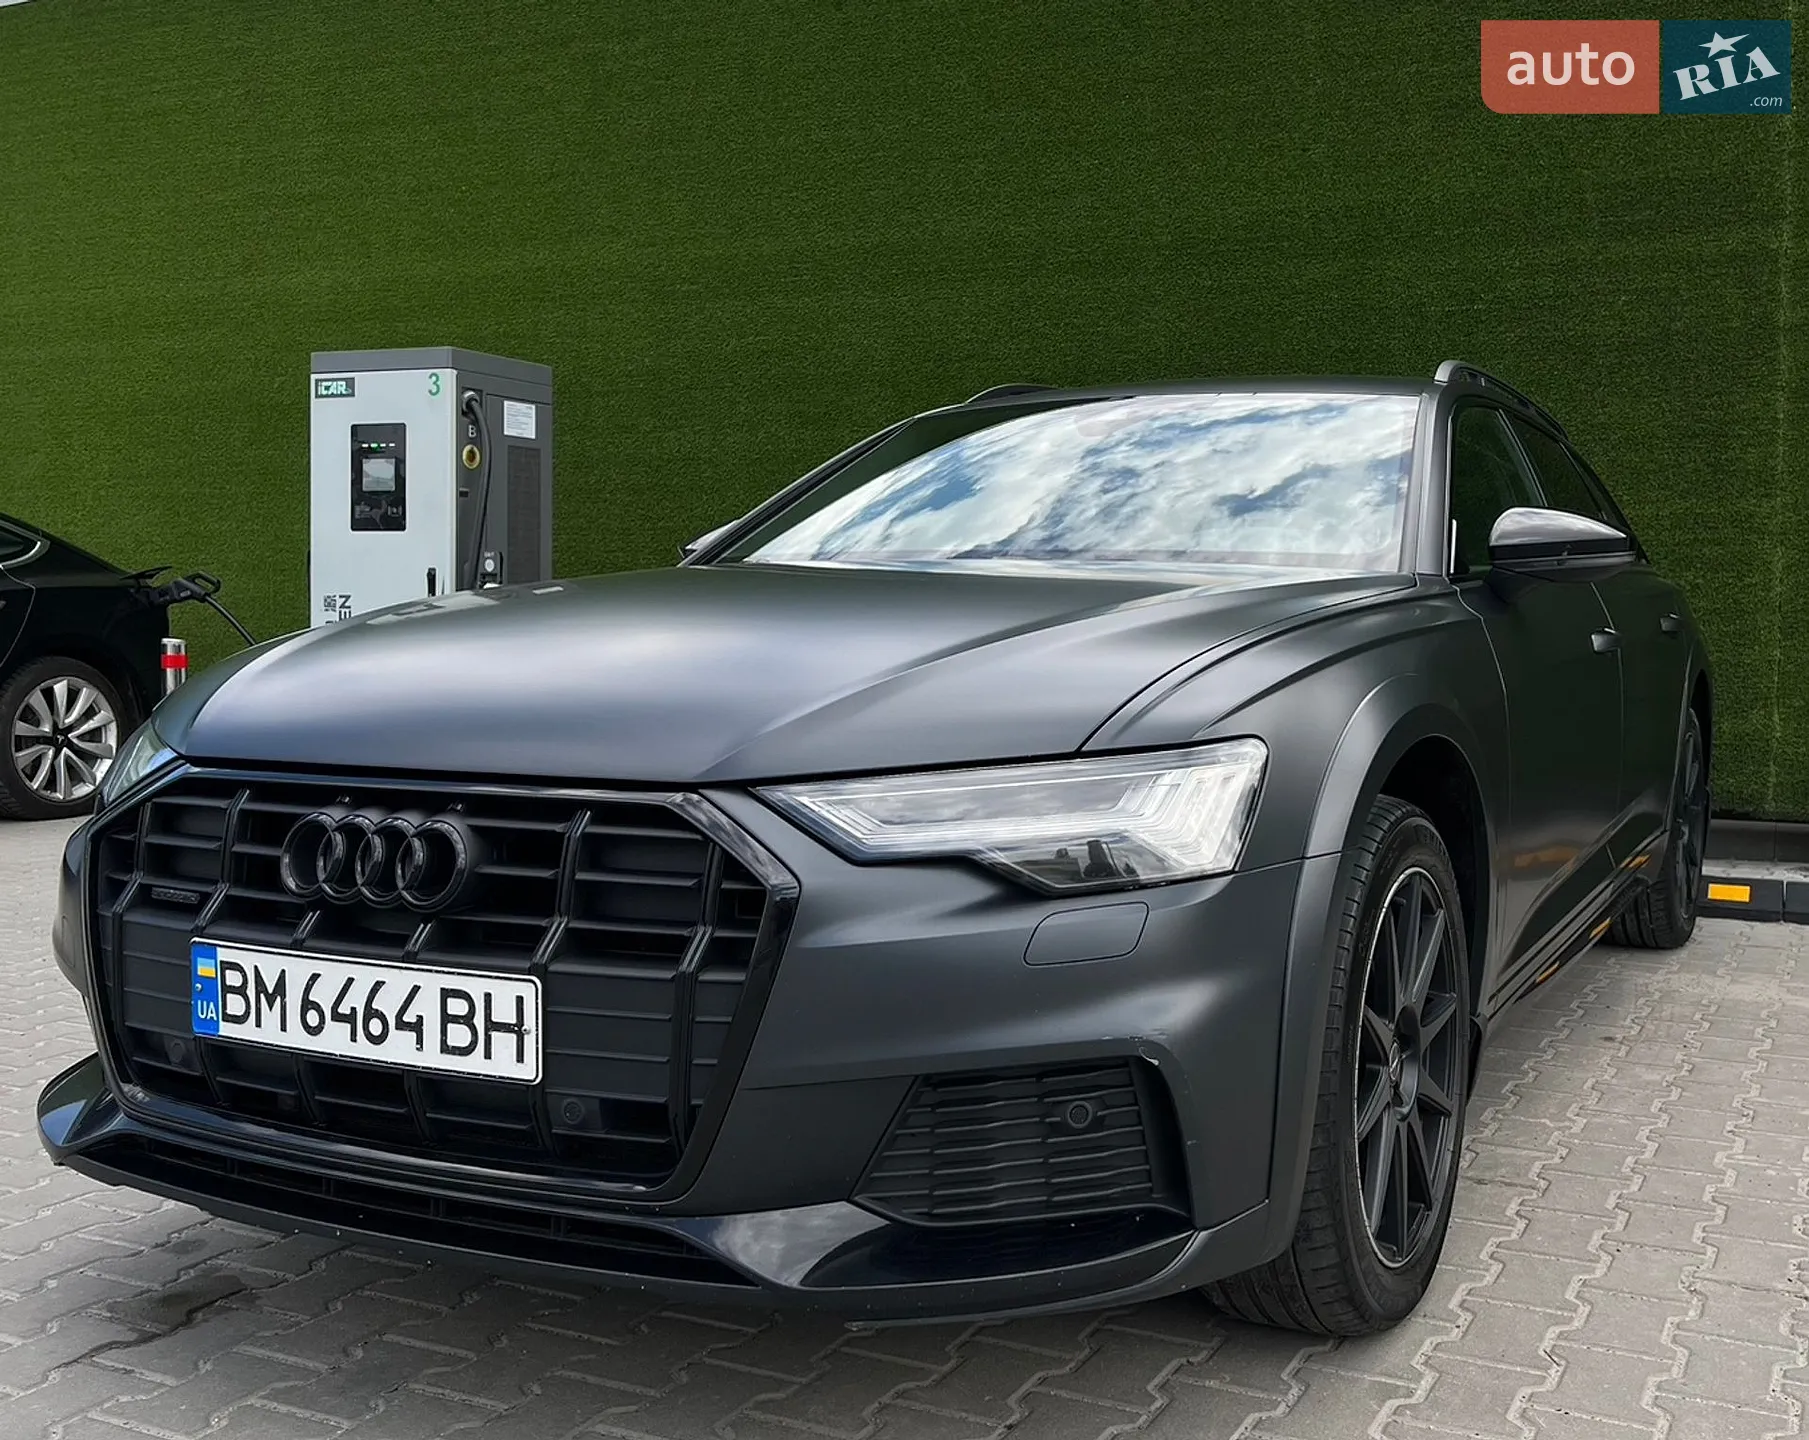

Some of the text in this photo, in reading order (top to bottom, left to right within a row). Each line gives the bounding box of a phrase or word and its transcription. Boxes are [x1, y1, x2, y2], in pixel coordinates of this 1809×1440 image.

[428, 372, 440, 396] 3
[468, 424, 477, 438] B
[197, 1000, 218, 1022] UA
[219, 959, 525, 1064] BM 6464 BH
